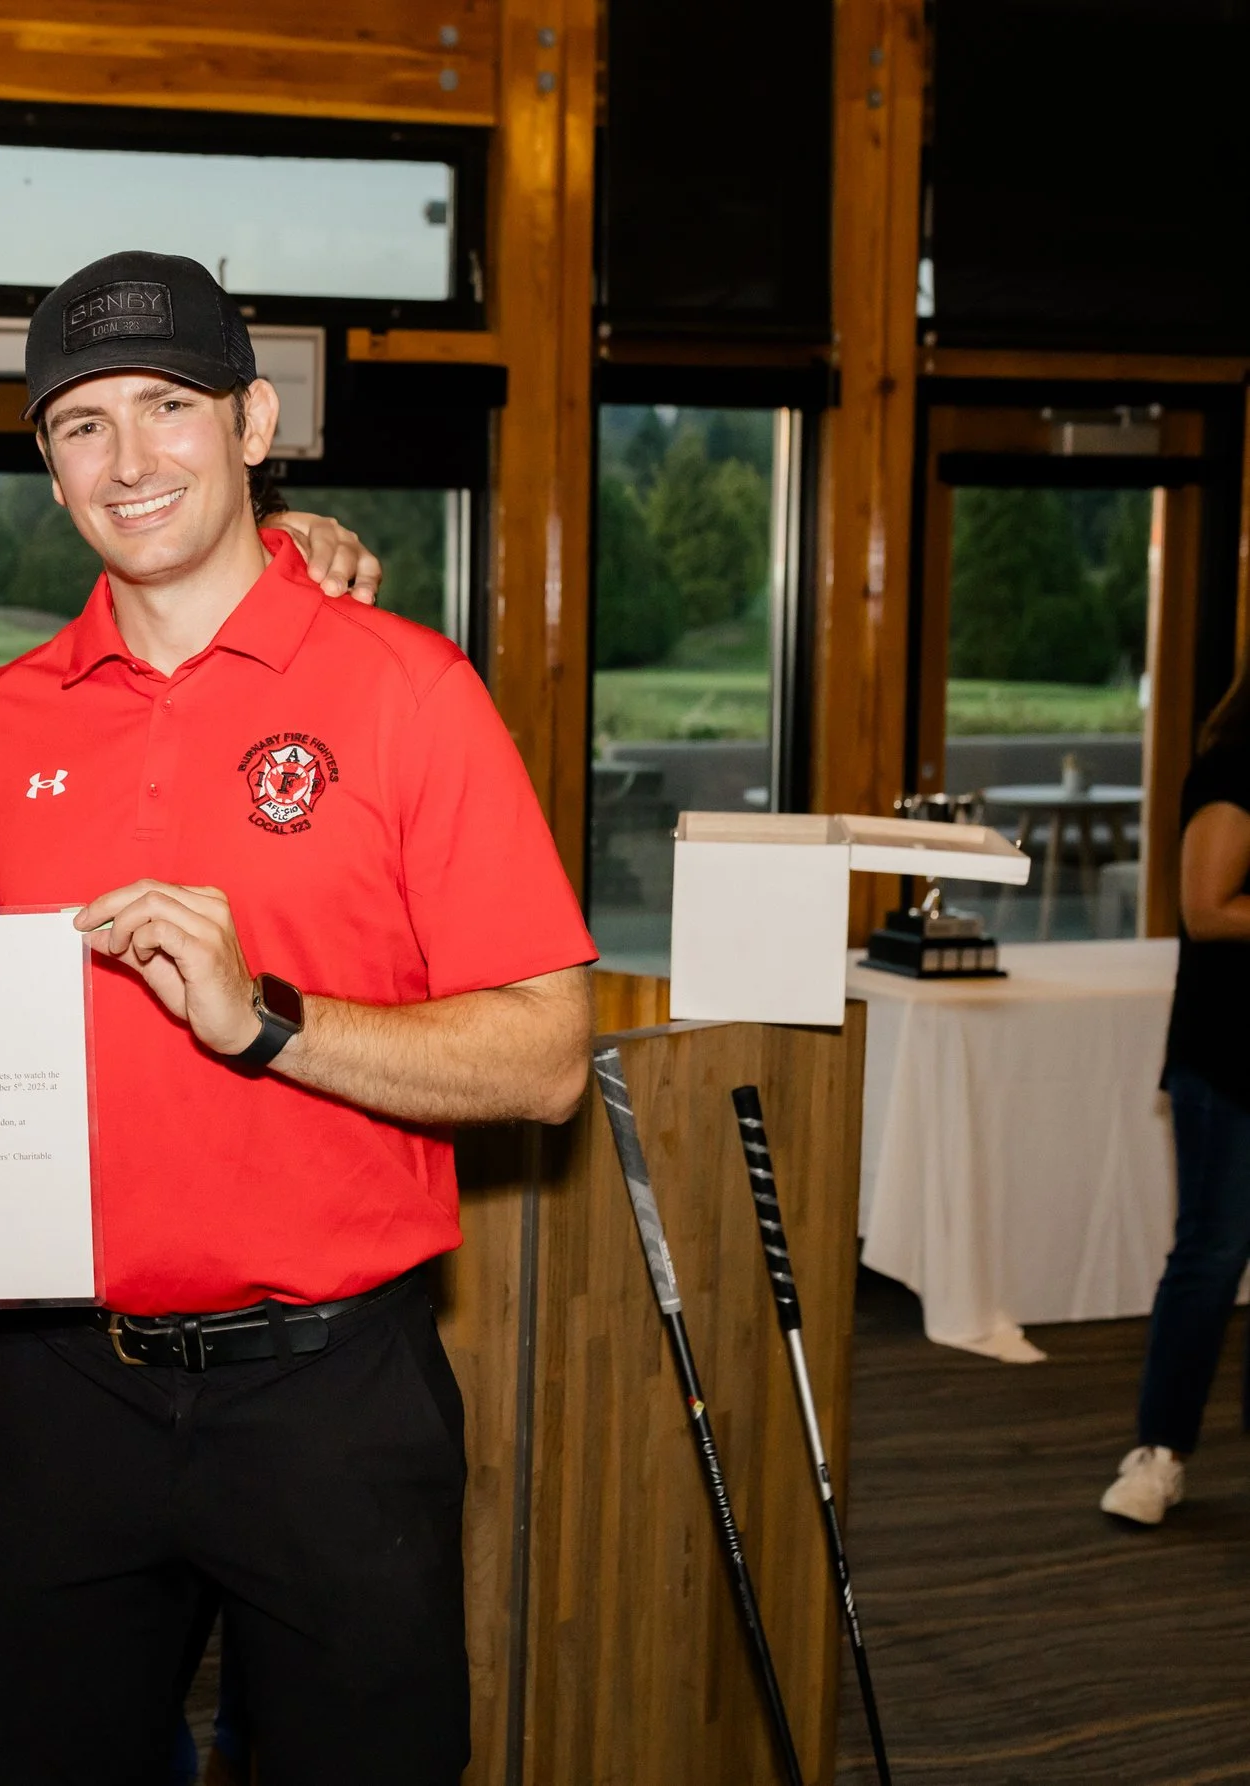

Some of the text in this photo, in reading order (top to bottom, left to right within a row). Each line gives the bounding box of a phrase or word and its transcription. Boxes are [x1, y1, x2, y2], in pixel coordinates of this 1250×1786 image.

[71, 292, 161, 325] BRNBY
[93, 322, 120, 337] LOCAL
[237, 733, 339, 783] BURNABY FIRE FIGHTERS
[286, 748, 300, 762] A
[277, 772, 300, 794] F
[248, 812, 312, 835] LOCAL 323
[273, 813, 288, 821] CLC
[24, 1071, 46, 1079] watch
[48, 1071, 60, 1079] the
[13, 1152, 52, 1160] Charitable
